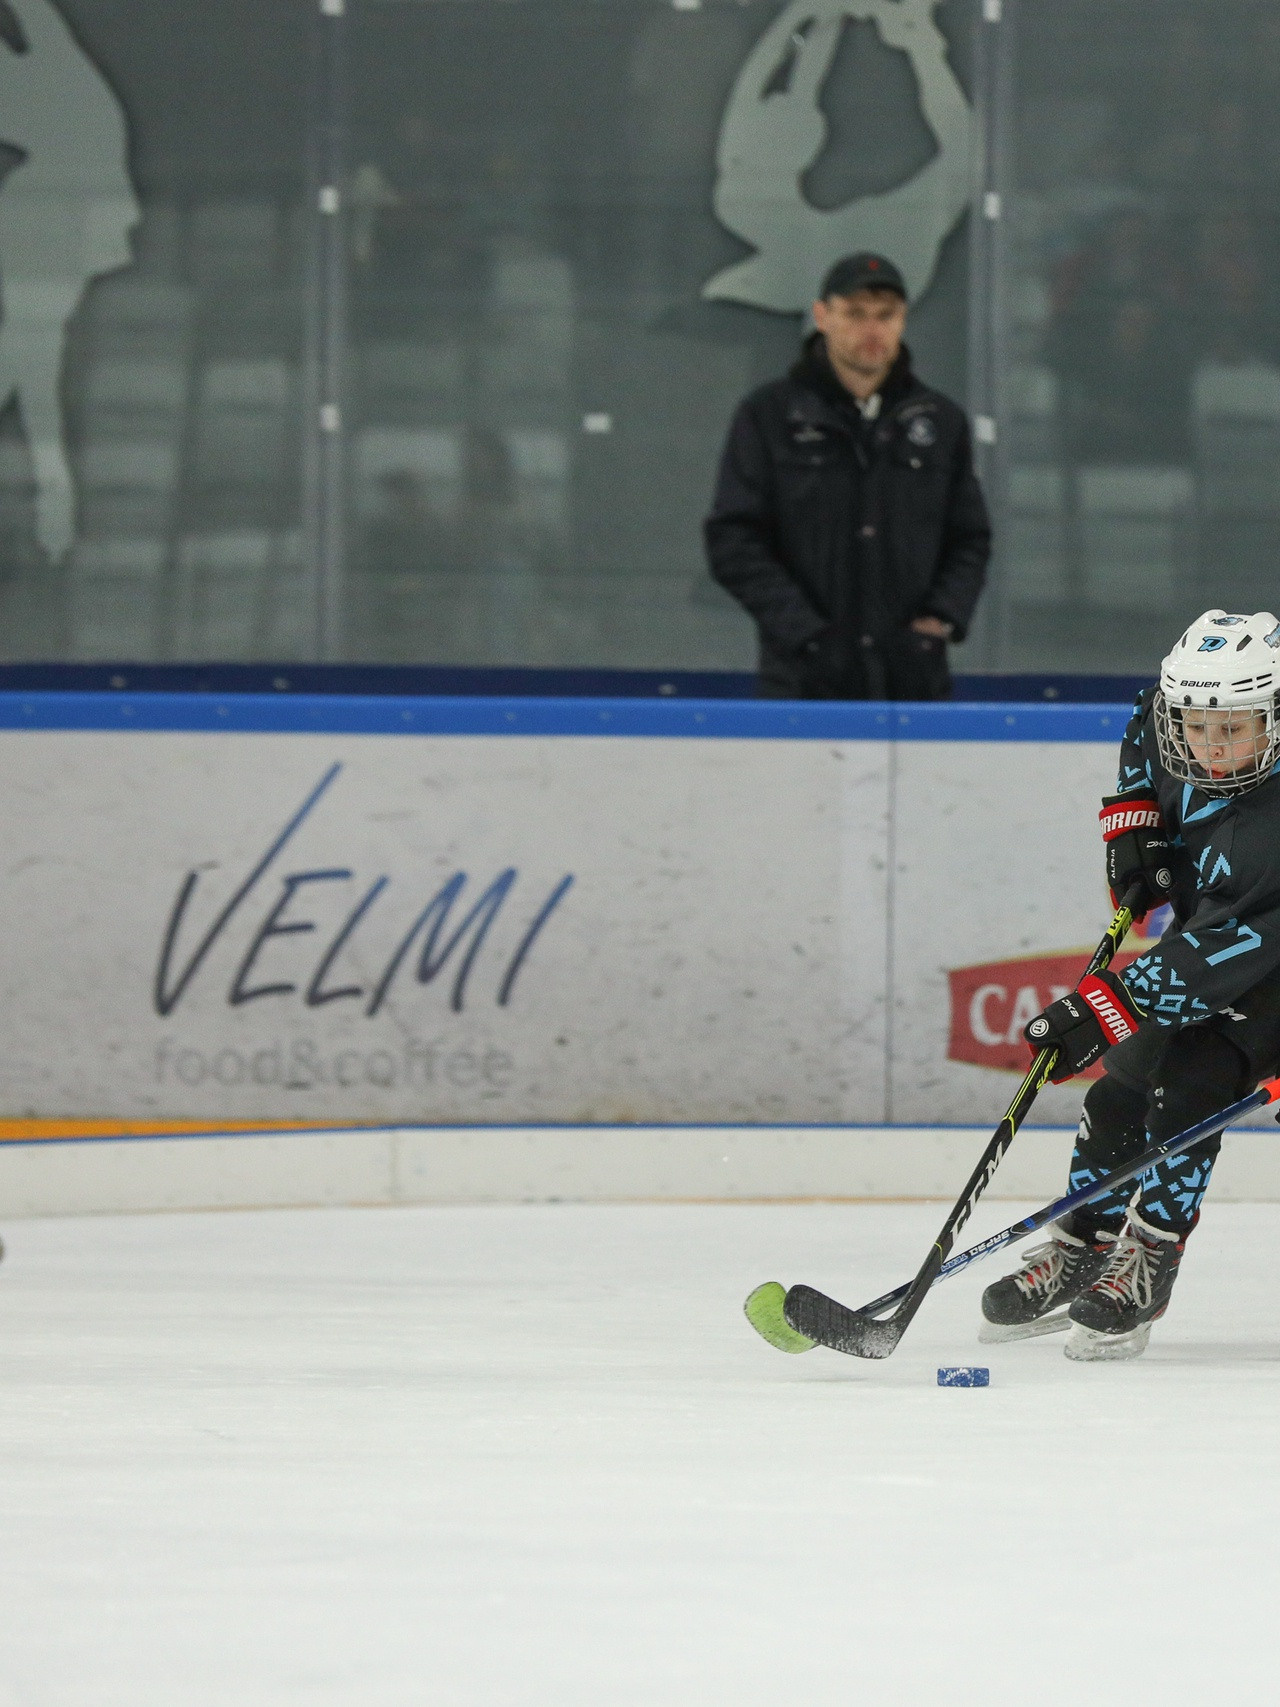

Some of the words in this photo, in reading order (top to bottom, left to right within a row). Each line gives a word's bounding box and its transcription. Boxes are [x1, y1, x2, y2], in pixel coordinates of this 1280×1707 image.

[1180, 680, 1221, 688] BAUER
[1101, 810, 1160, 834] RRIOR
[154, 760, 576, 1018] VELMI
[153, 1036, 516, 1089] food&coffee
[950, 1141, 1003, 1245] CCM
